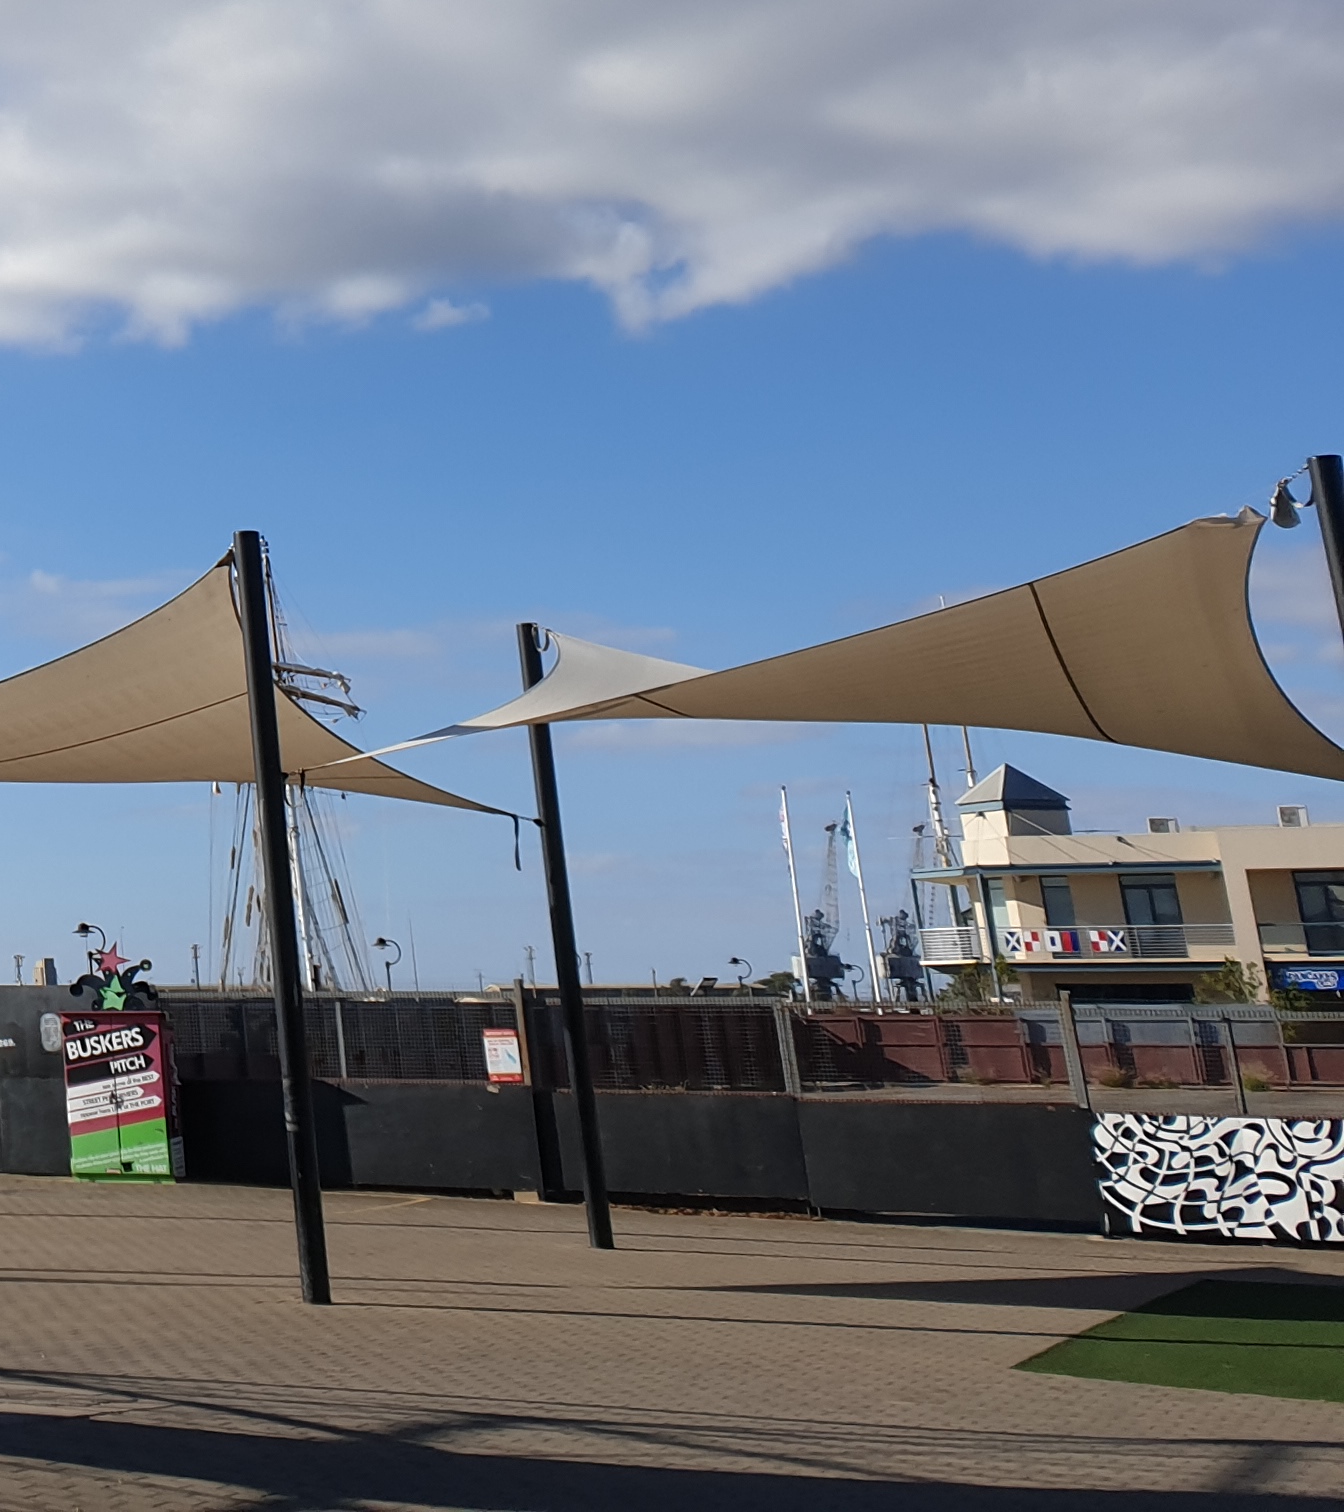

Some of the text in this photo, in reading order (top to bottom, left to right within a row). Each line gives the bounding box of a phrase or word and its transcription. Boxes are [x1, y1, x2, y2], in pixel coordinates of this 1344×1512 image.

[73, 1019, 95, 1032] THE
[65, 1027, 144, 1061] BUSKERS
[109, 1055, 147, 1075] PITCH
[82, 1094, 103, 1106] STREET
[140, 1098, 155, 1107] PORT
